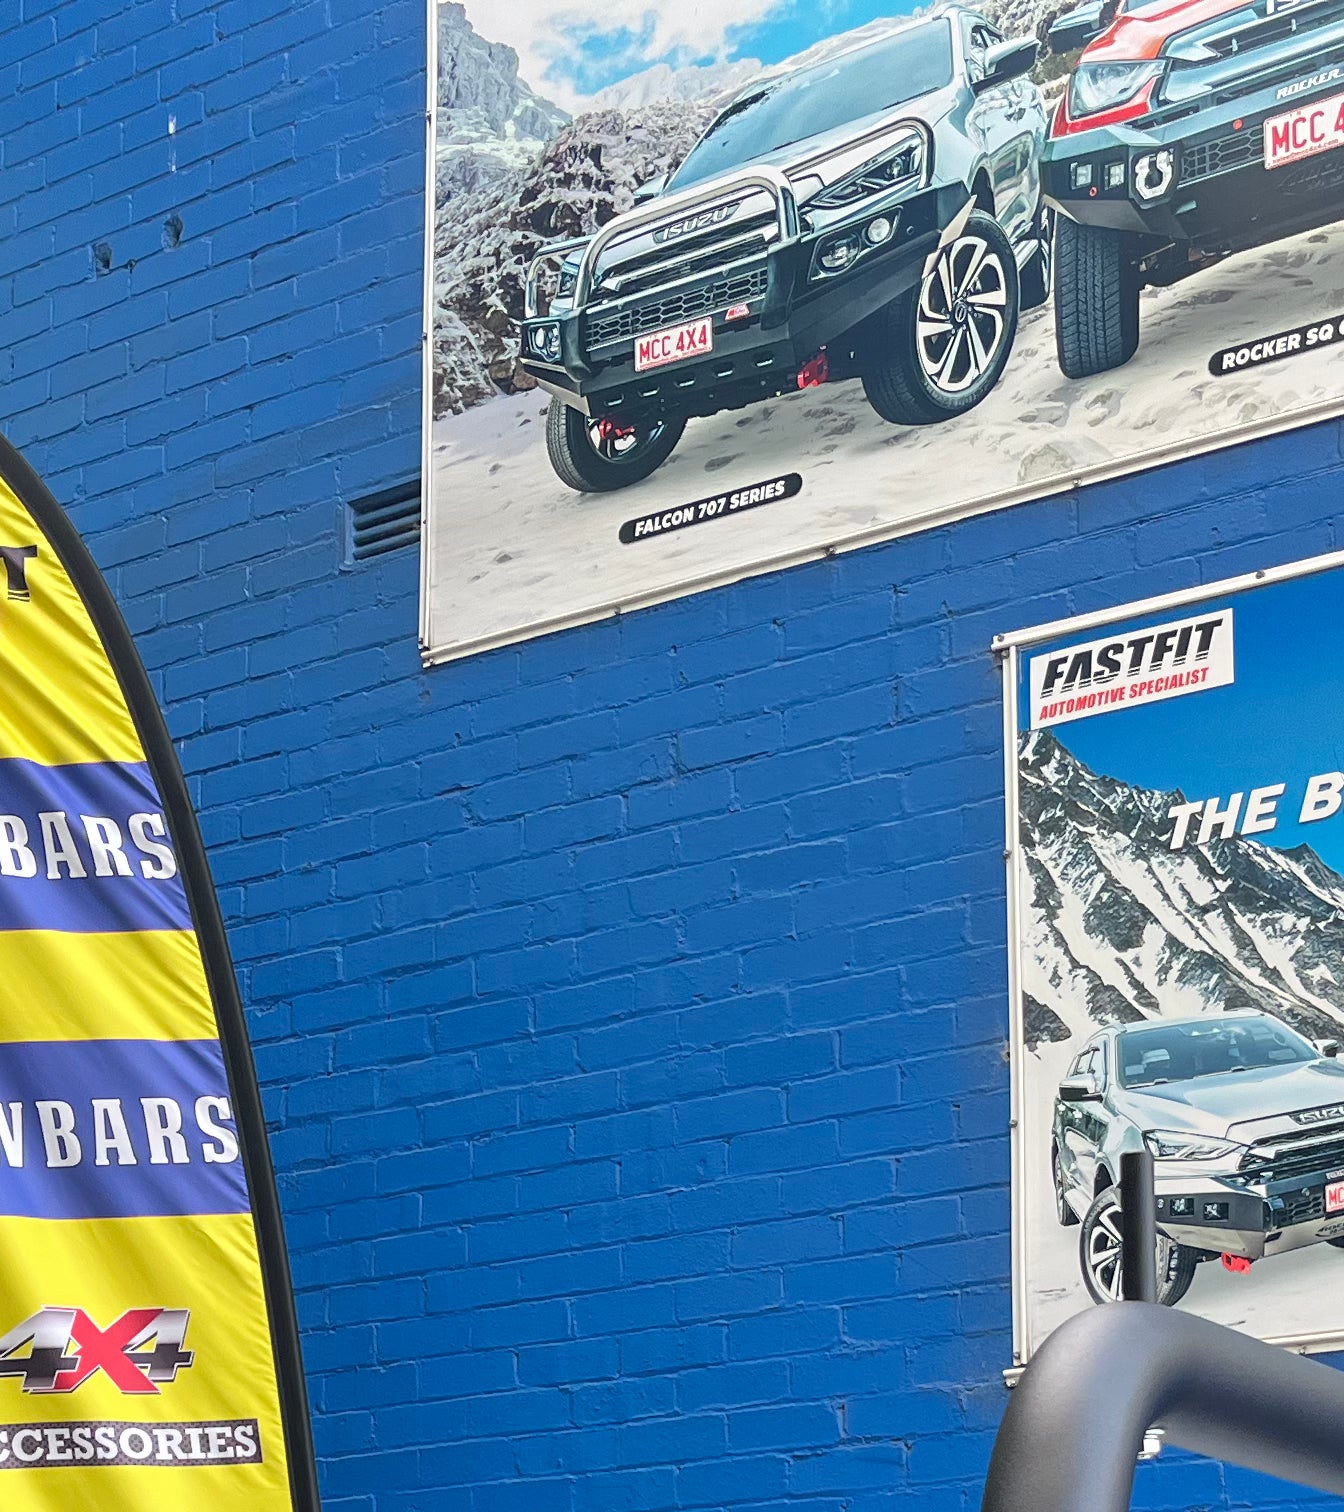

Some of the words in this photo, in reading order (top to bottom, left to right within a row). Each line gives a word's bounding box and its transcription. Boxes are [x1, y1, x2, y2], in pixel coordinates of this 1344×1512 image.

[1271, 110, 1325, 157] MCC
[662, 205, 729, 241] ISUZU
[639, 335, 671, 364] MCC
[676, 324, 707, 352] 4X4
[1222, 333, 1301, 370] ROCKER
[1306, 323, 1334, 346] SQ
[634, 506, 695, 537] FALCON
[698, 496, 727, 519] 707
[729, 480, 786, 510] SERIES
[1040, 618, 1224, 698] FASTFIT
[1039, 685, 1125, 720] AUTOMOTIVE
[1129, 667, 1210, 699] SPECIALIST
[1167, 782, 1286, 850] THE
